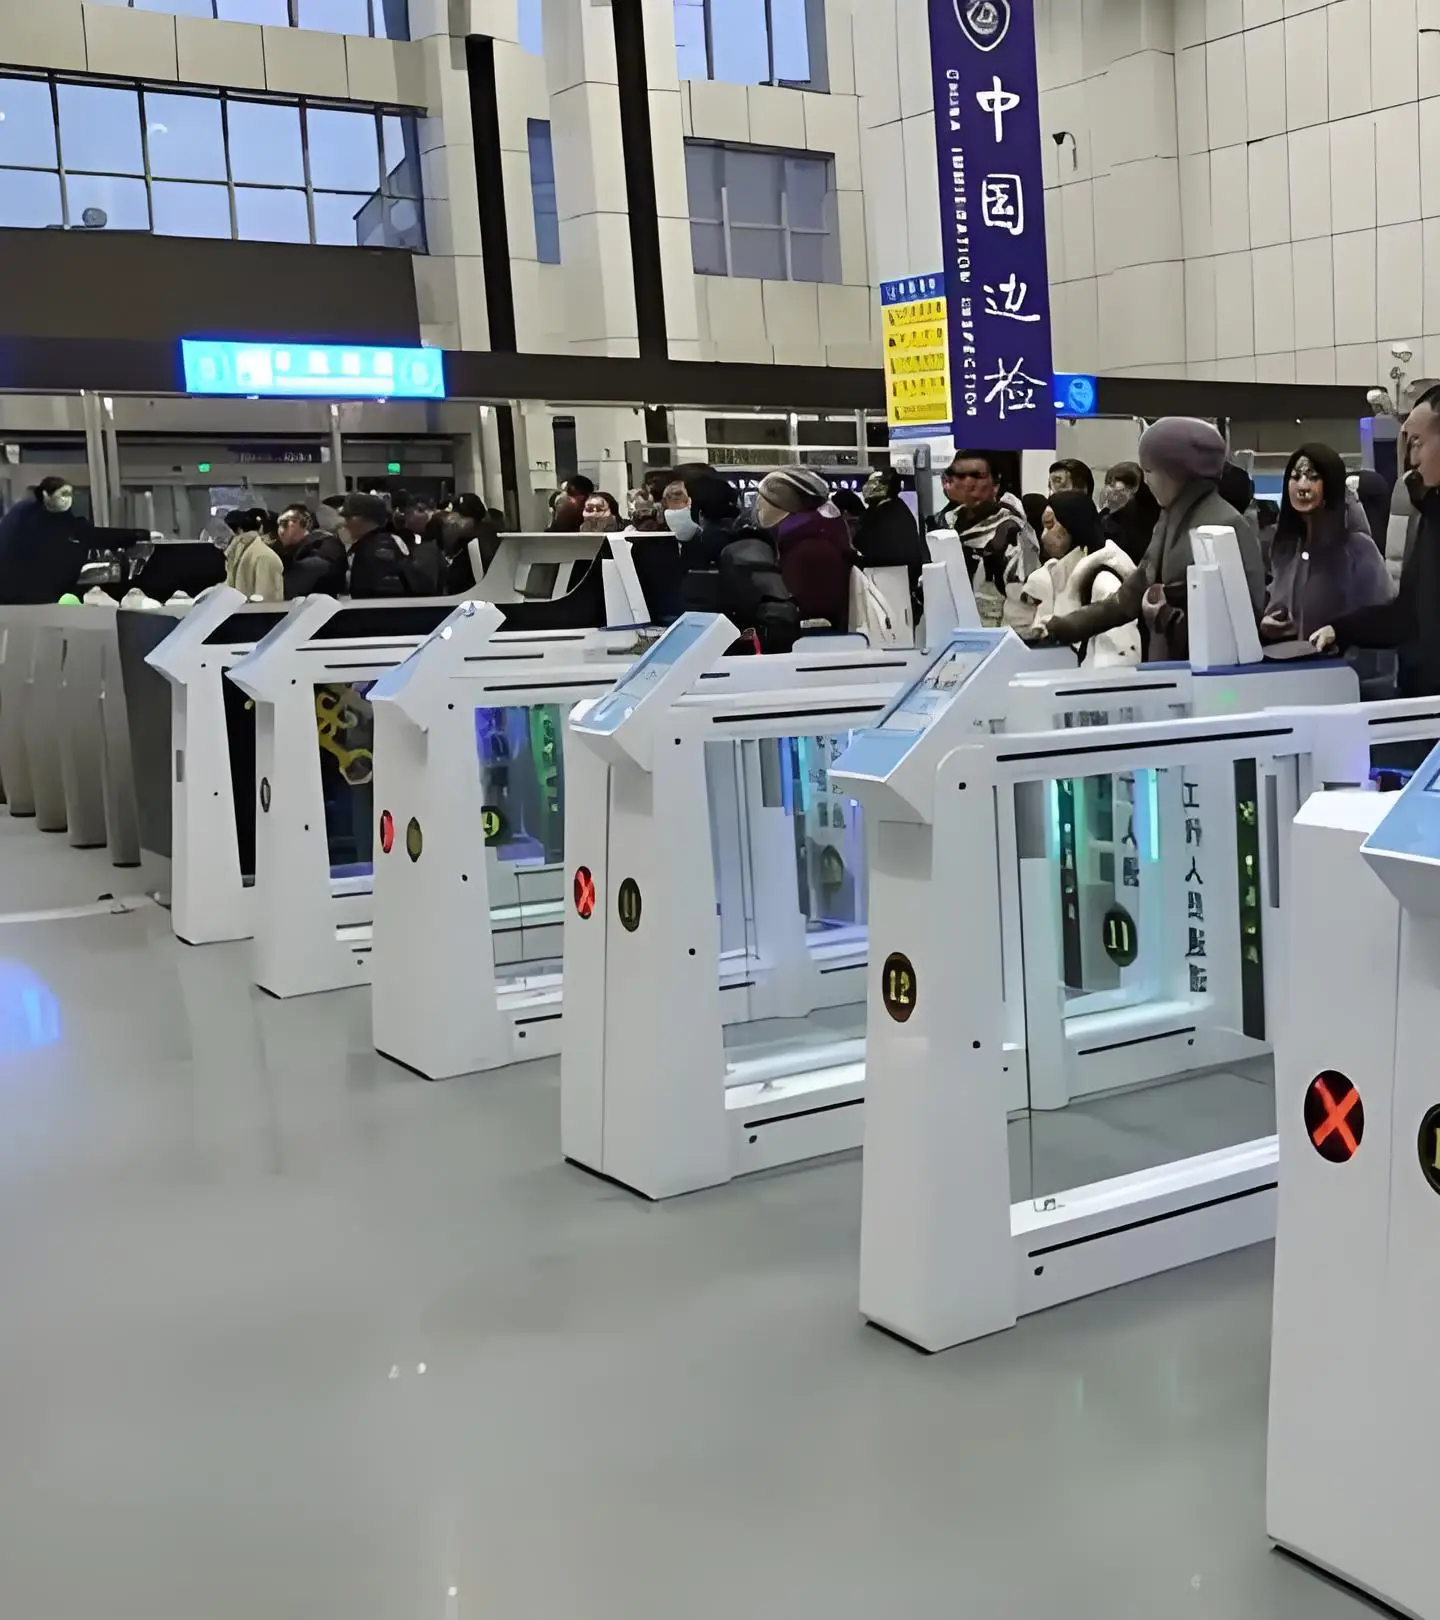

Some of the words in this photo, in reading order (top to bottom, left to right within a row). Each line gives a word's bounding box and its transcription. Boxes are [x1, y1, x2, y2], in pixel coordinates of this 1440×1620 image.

[975, 75, 1048, 420] 中国边检
[1107, 919, 1129, 952] 11
[889, 969, 911, 1004] 12
